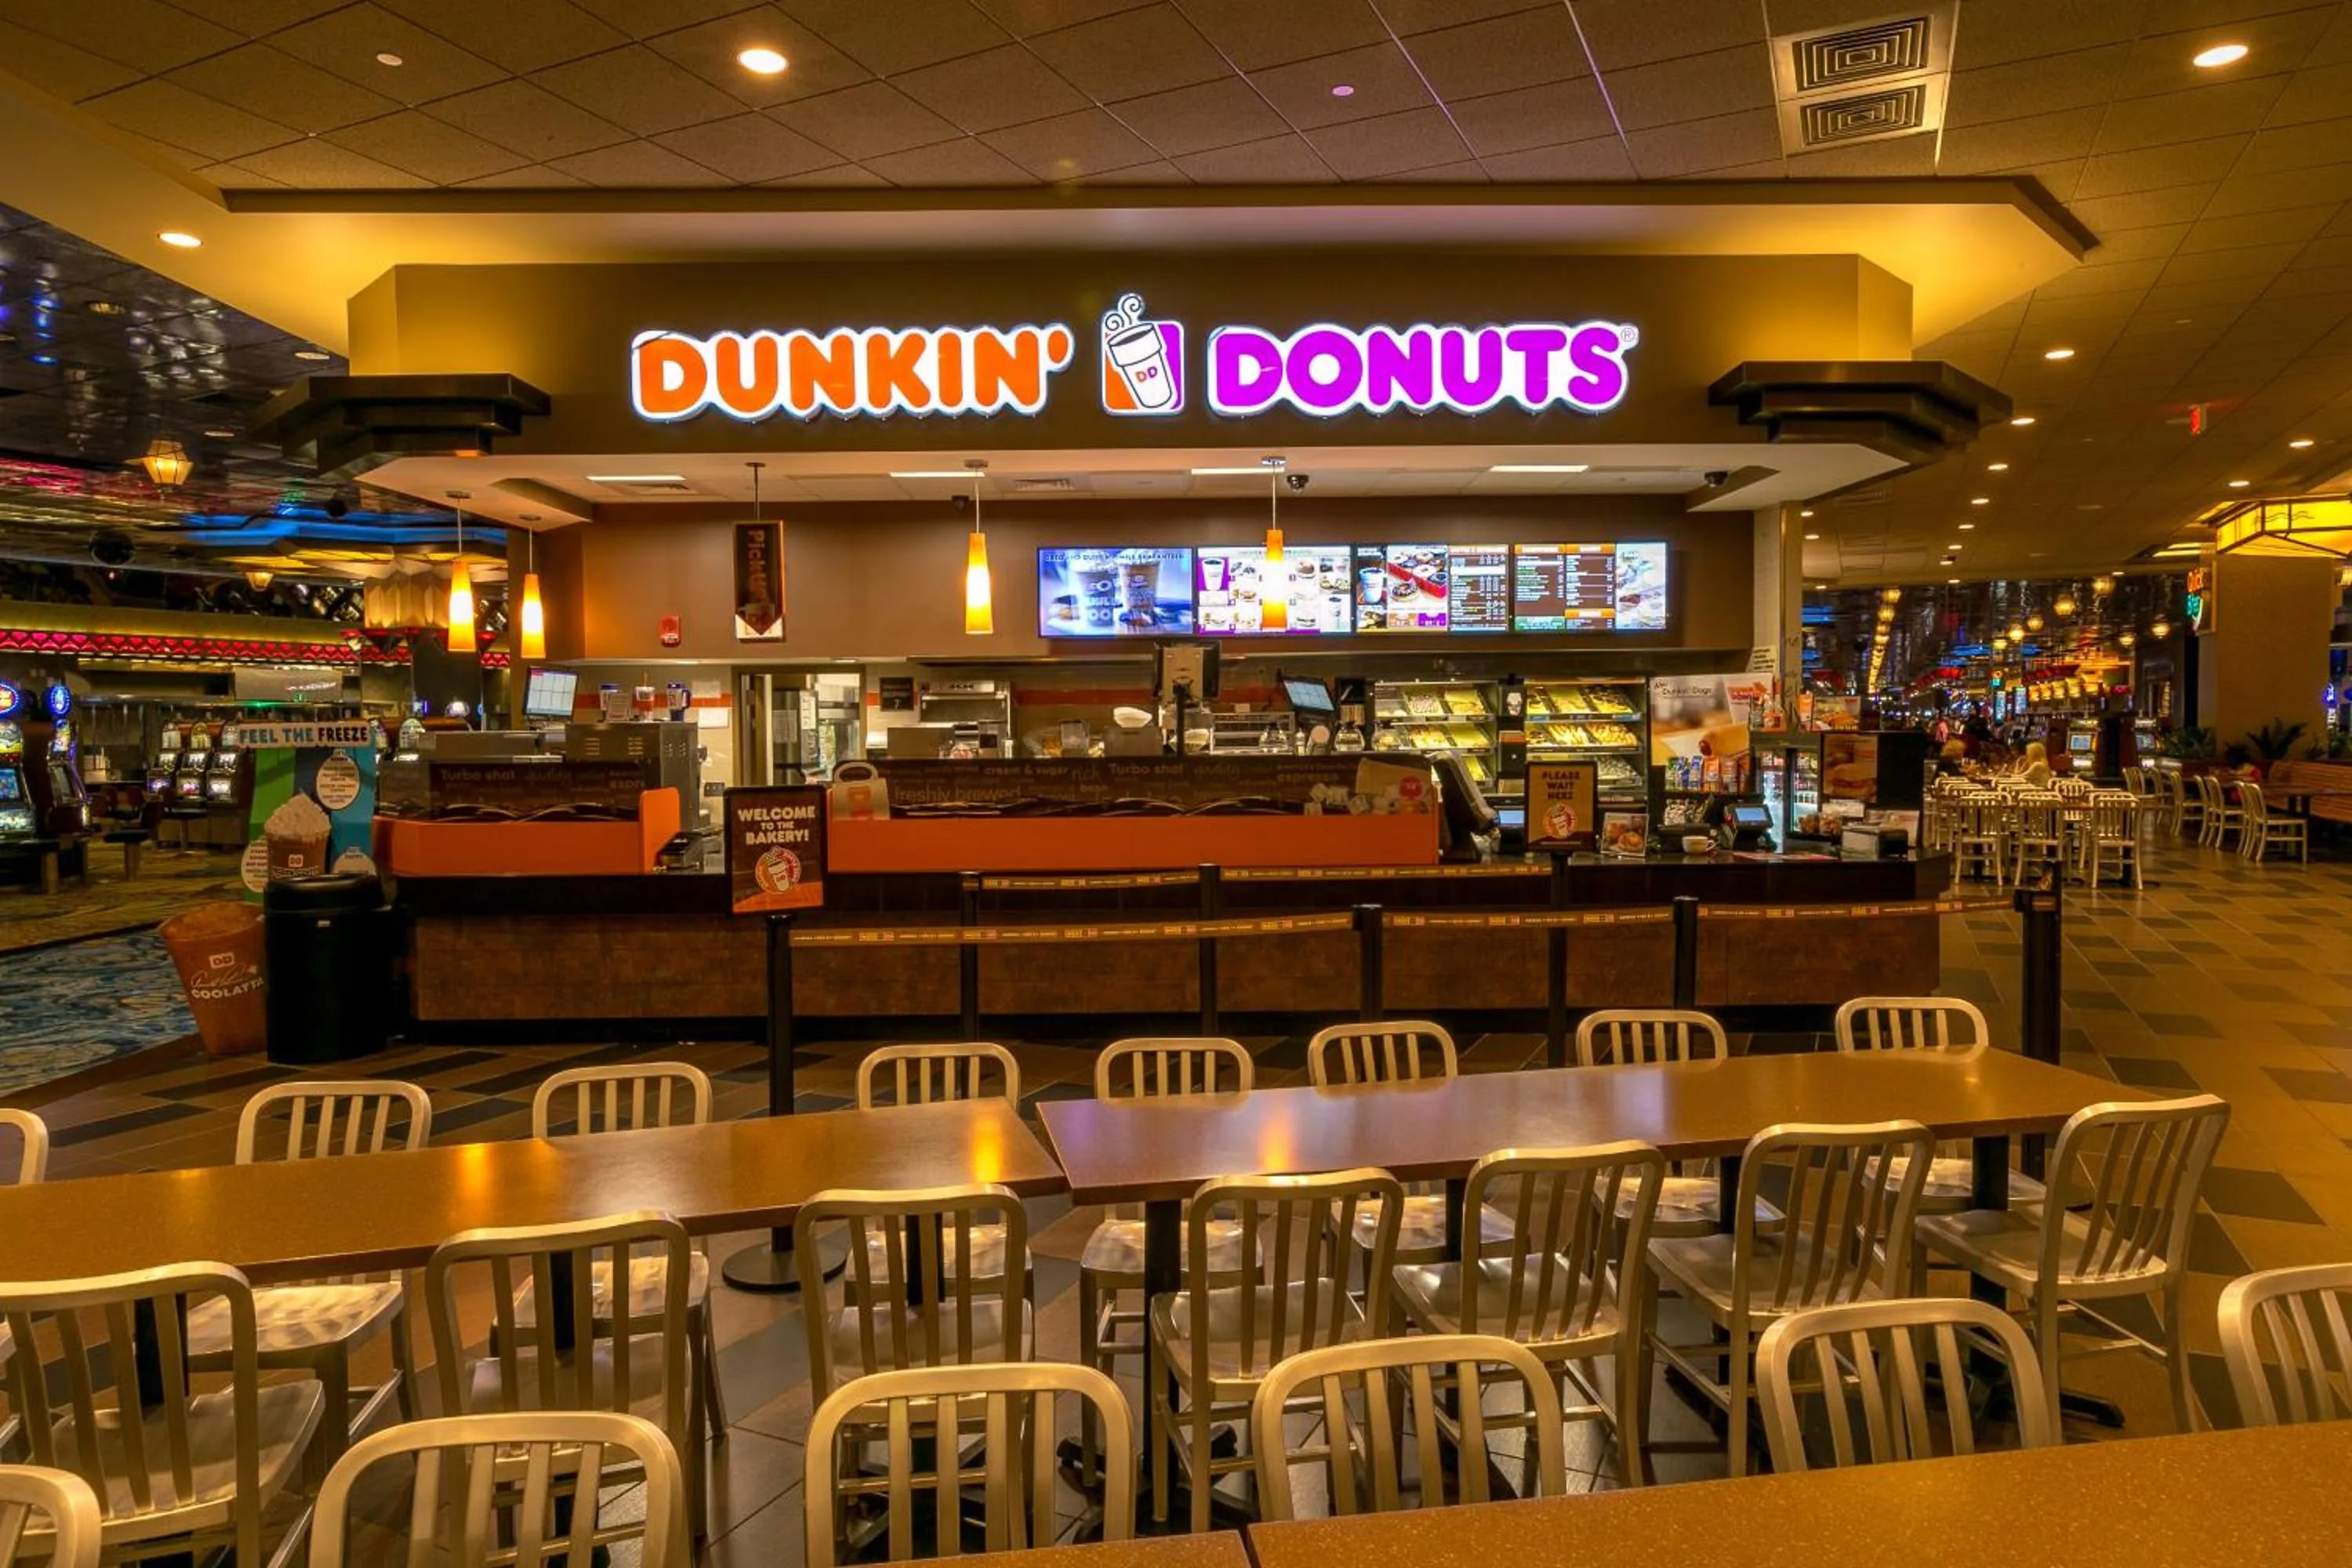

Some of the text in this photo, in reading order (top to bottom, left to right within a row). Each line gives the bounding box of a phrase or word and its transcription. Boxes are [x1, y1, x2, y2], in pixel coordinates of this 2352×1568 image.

[639, 326, 1623, 412] DUNKIN' DONUTS
[1135, 366, 1158, 382] DD
[239, 727, 368, 743] FEEL THE FREEZE
[440, 769, 514, 781] Turbo shot
[1109, 763, 1151, 775] Turbo
[1543, 771, 1580, 780] PLEASE
[1548, 782, 1574, 790] WAIT
[737, 806, 815, 822] WELCOME
[746, 829, 809, 844] BAKERY!
